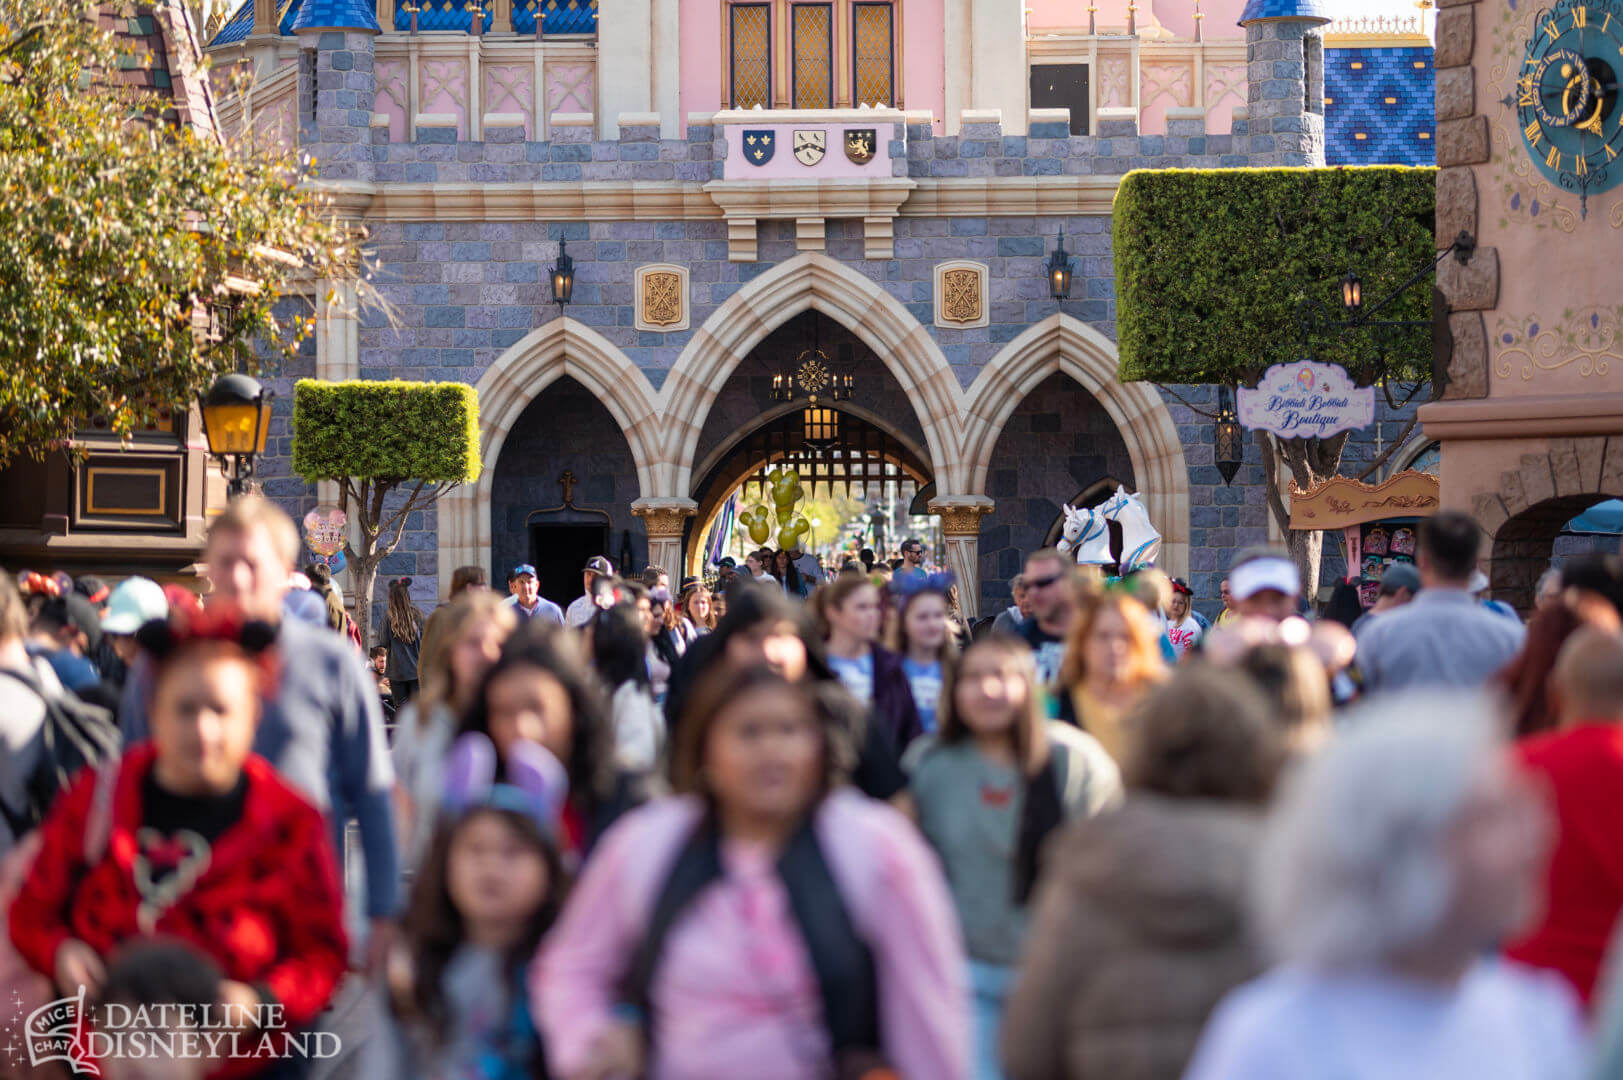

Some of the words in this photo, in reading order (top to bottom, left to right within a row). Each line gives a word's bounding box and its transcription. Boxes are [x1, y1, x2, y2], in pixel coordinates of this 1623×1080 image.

[1571, 6, 1586, 29] XII
[1543, 20, 1561, 44] XI
[1524, 119, 1543, 148] VIII
[1546, 145, 1561, 172] VII
[1576, 154, 1588, 176] VI
[1264, 394, 1306, 412] Bibbidi
[1306, 394, 1348, 412] Bobbidi
[1277, 410, 1339, 433] Boutique
